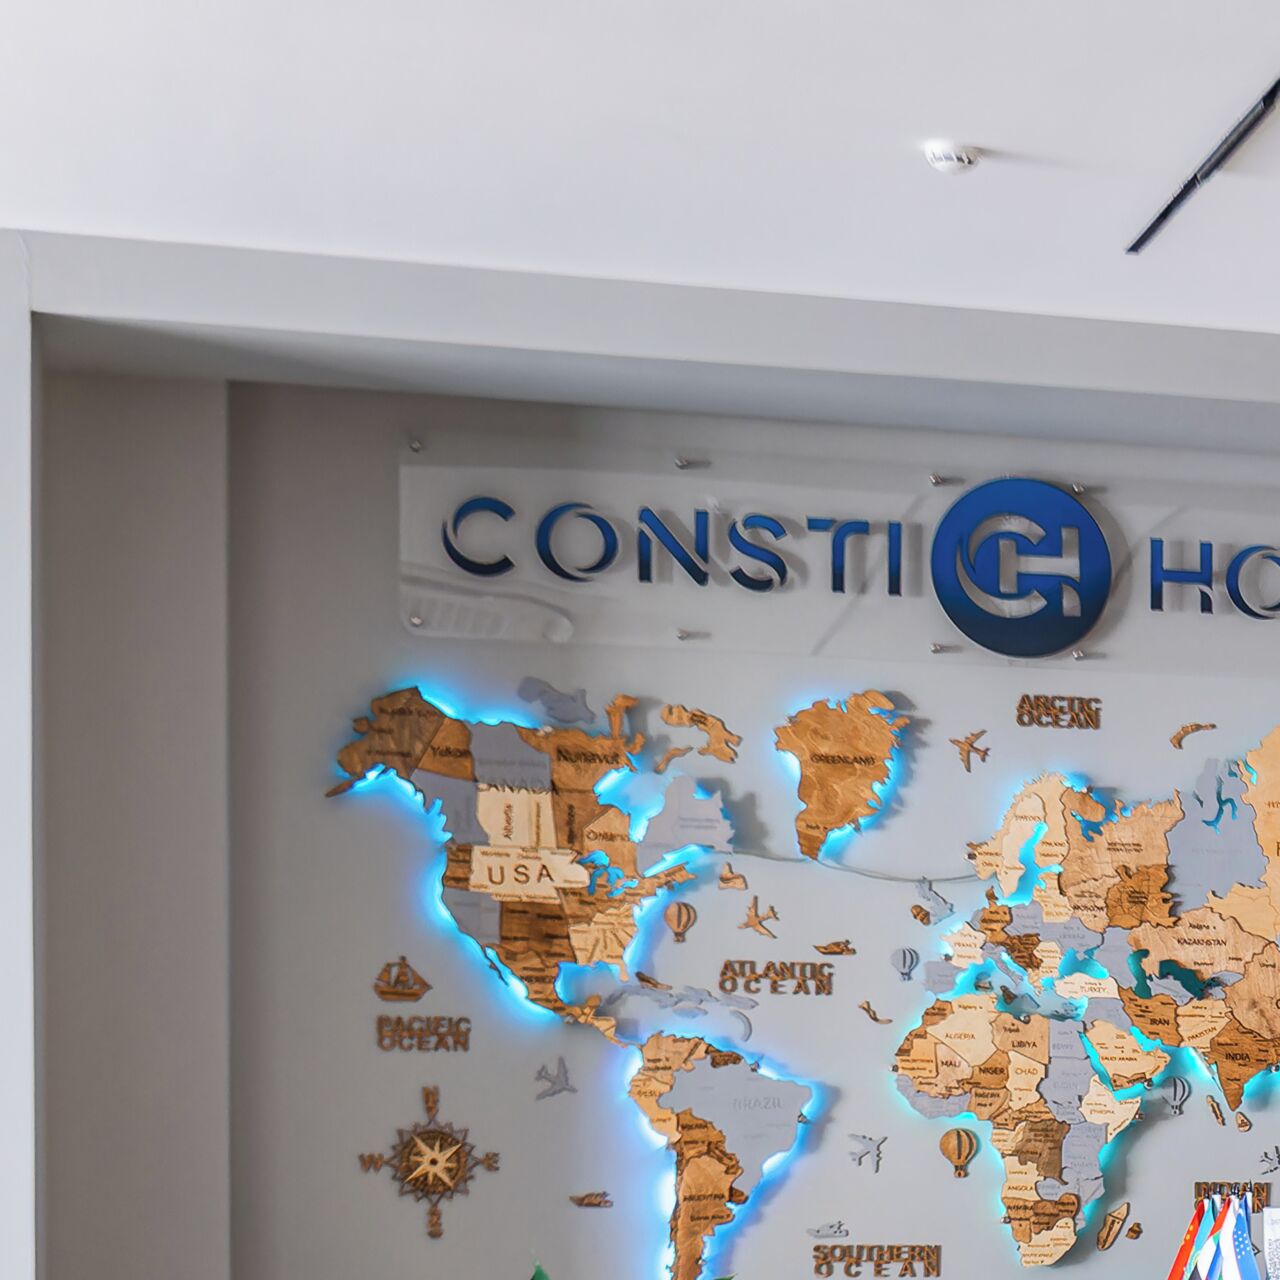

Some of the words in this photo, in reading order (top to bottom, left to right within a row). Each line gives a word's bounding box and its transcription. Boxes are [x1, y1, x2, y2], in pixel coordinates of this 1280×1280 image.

[442, 496, 903, 597] CONSTI
[487, 864, 554, 885] USA
[1177, 937, 1228, 947] KAZAKHSTAN
[720, 960, 834, 981] ATLANTIC
[719, 976, 833, 996] OCEAN
[375, 1014, 472, 1037] PACIFIC
[1149, 1018, 1170, 1027] IRAN
[376, 1032, 470, 1052] OCEAN
[1187, 1026, 1218, 1043] PAKISTAN
[940, 1059, 962, 1069] MALI
[1225, 1053, 1251, 1062] INDIA
[978, 1066, 1007, 1076] NIGER
[812, 1244, 942, 1264] SOUTHERN
[814, 1260, 942, 1279] OCEAN
